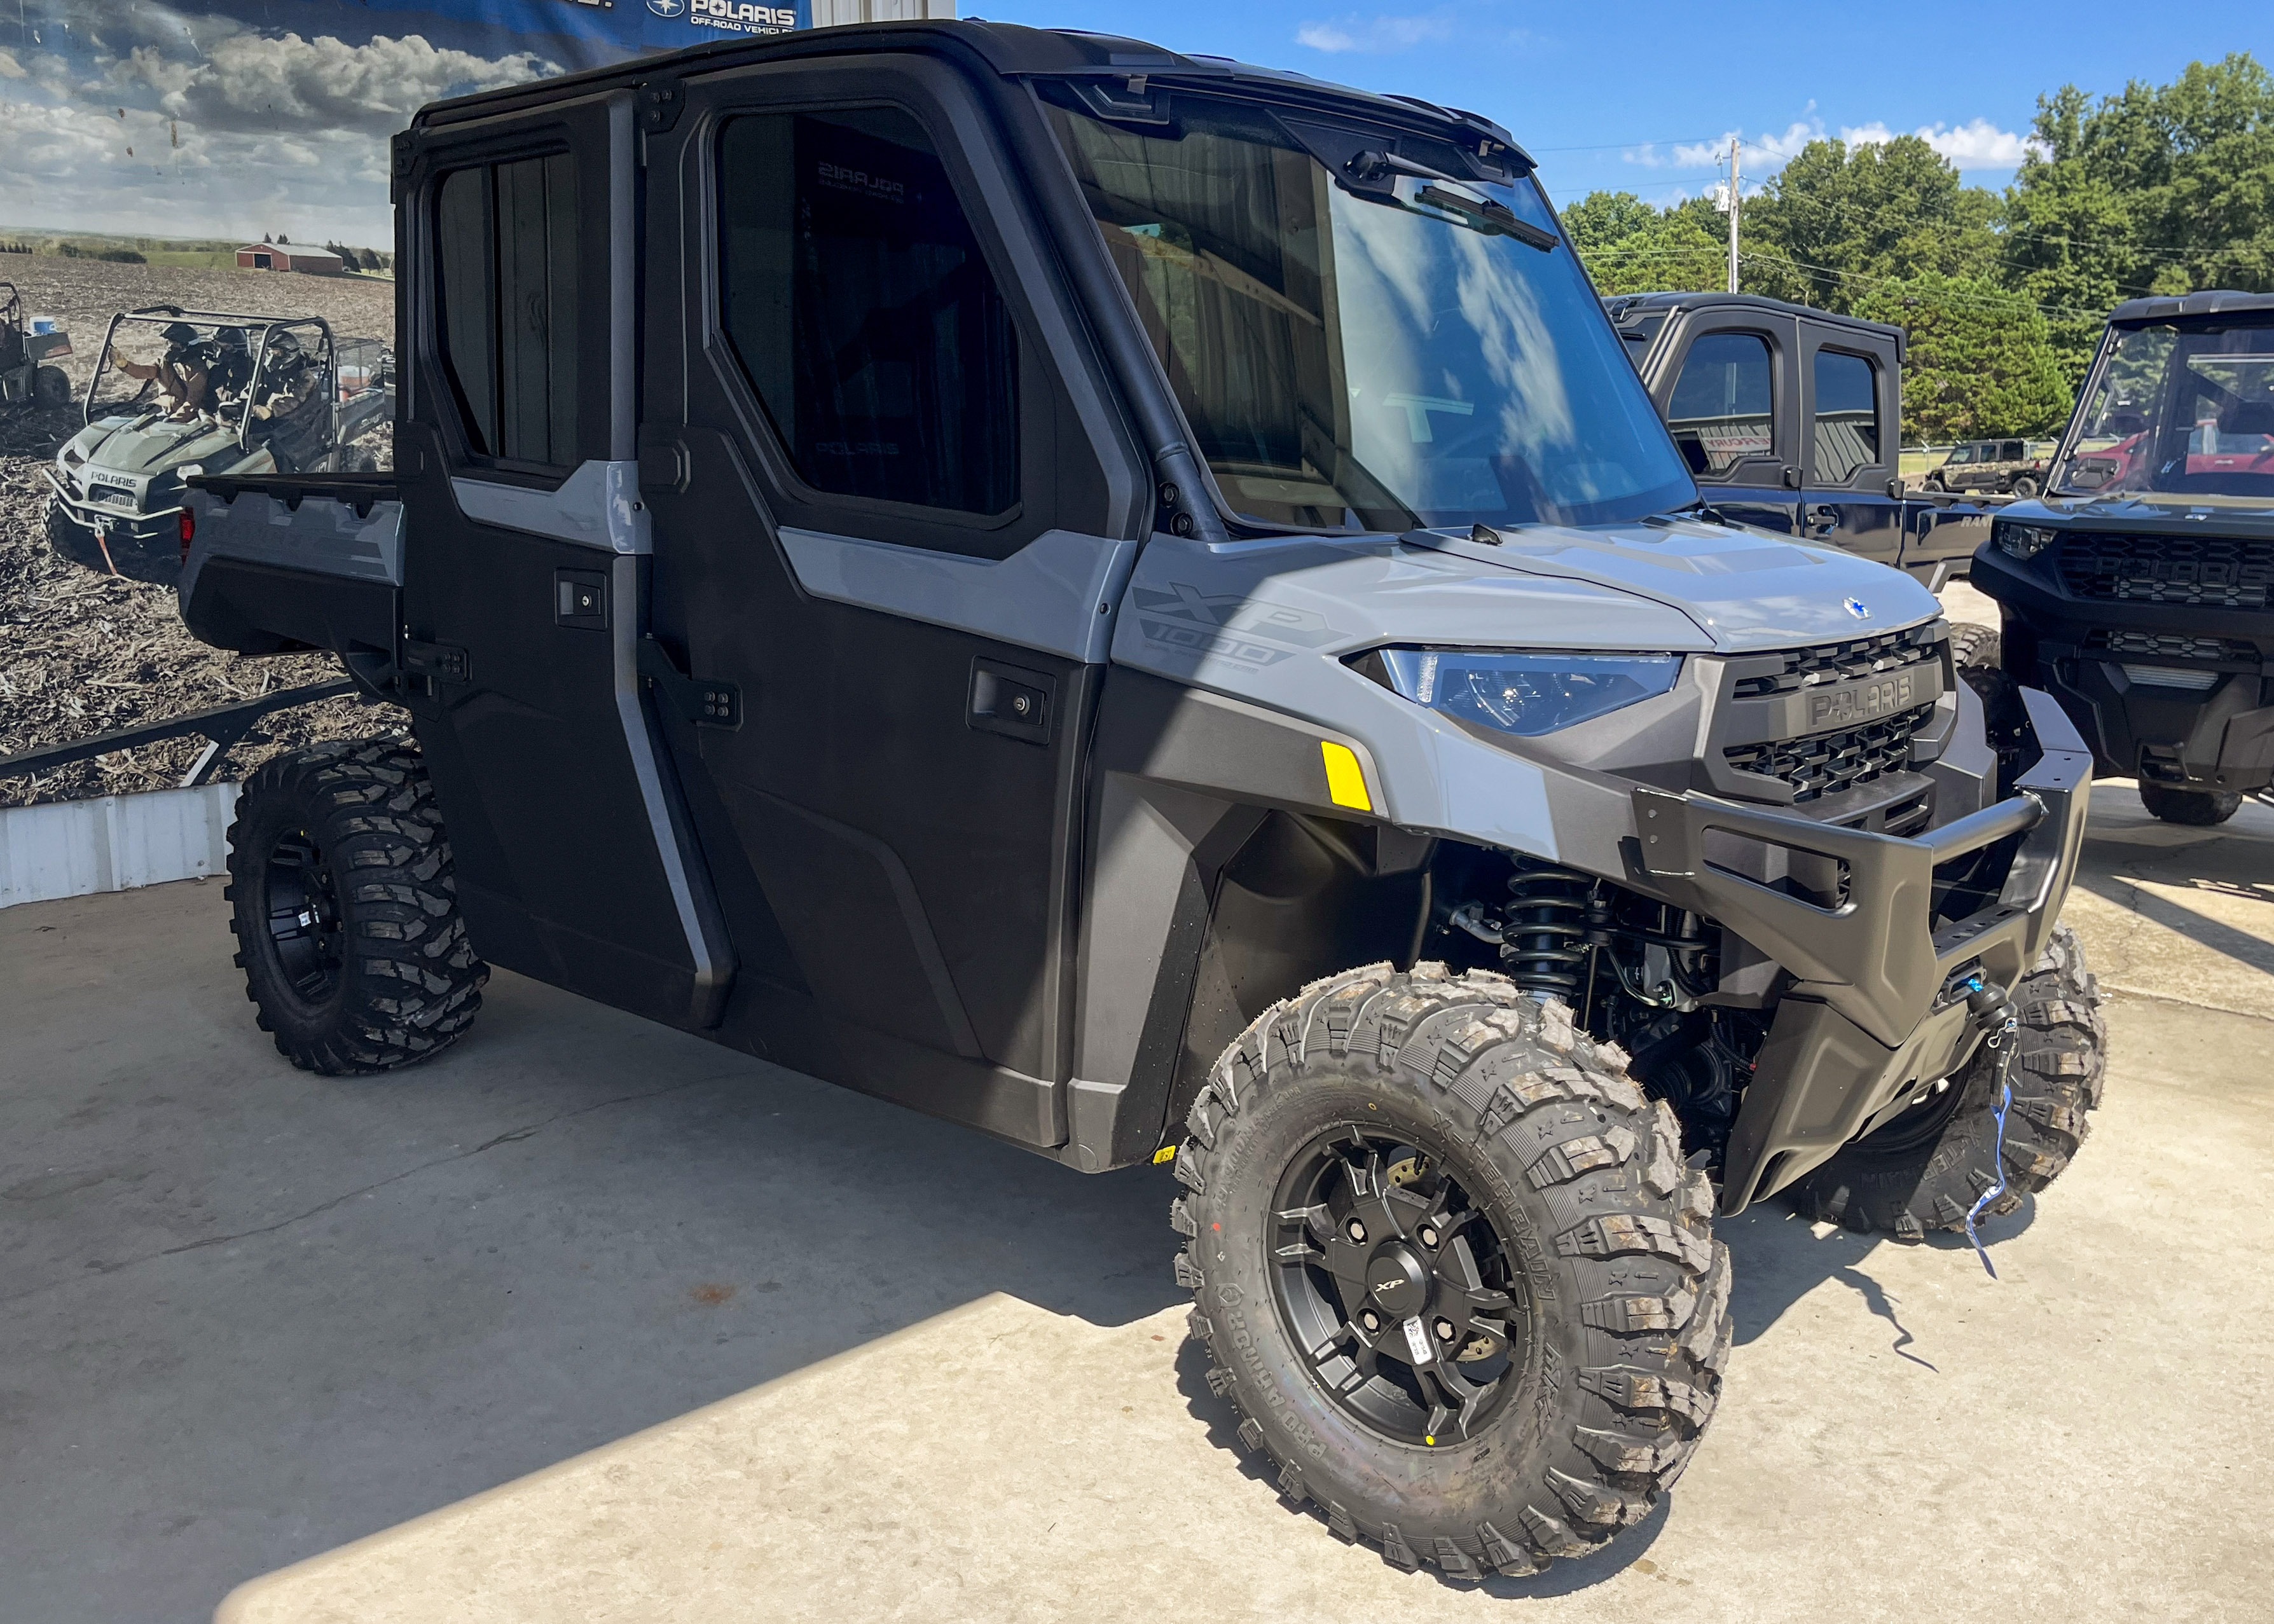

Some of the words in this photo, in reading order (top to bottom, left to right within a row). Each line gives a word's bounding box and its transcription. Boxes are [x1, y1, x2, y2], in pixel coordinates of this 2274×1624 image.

[691, 0, 795, 26] POLARIS
[691, 16, 741, 31] OFF-ROAD
[744, 25, 792, 34] VEHICL
[90, 471, 137, 488] POLARIS
[1960, 516, 1992, 528] RAN
[2096, 557, 2273, 586] POLARIS
[1135, 581, 1345, 643] XP
[1152, 623, 1274, 666] 1000
[1811, 676, 1911, 727] POLARIS
[1375, 1279, 1404, 1292] XP
[1226, 1310, 1286, 1409] ARMOR
[1283, 1410, 1327, 1462] PRO
